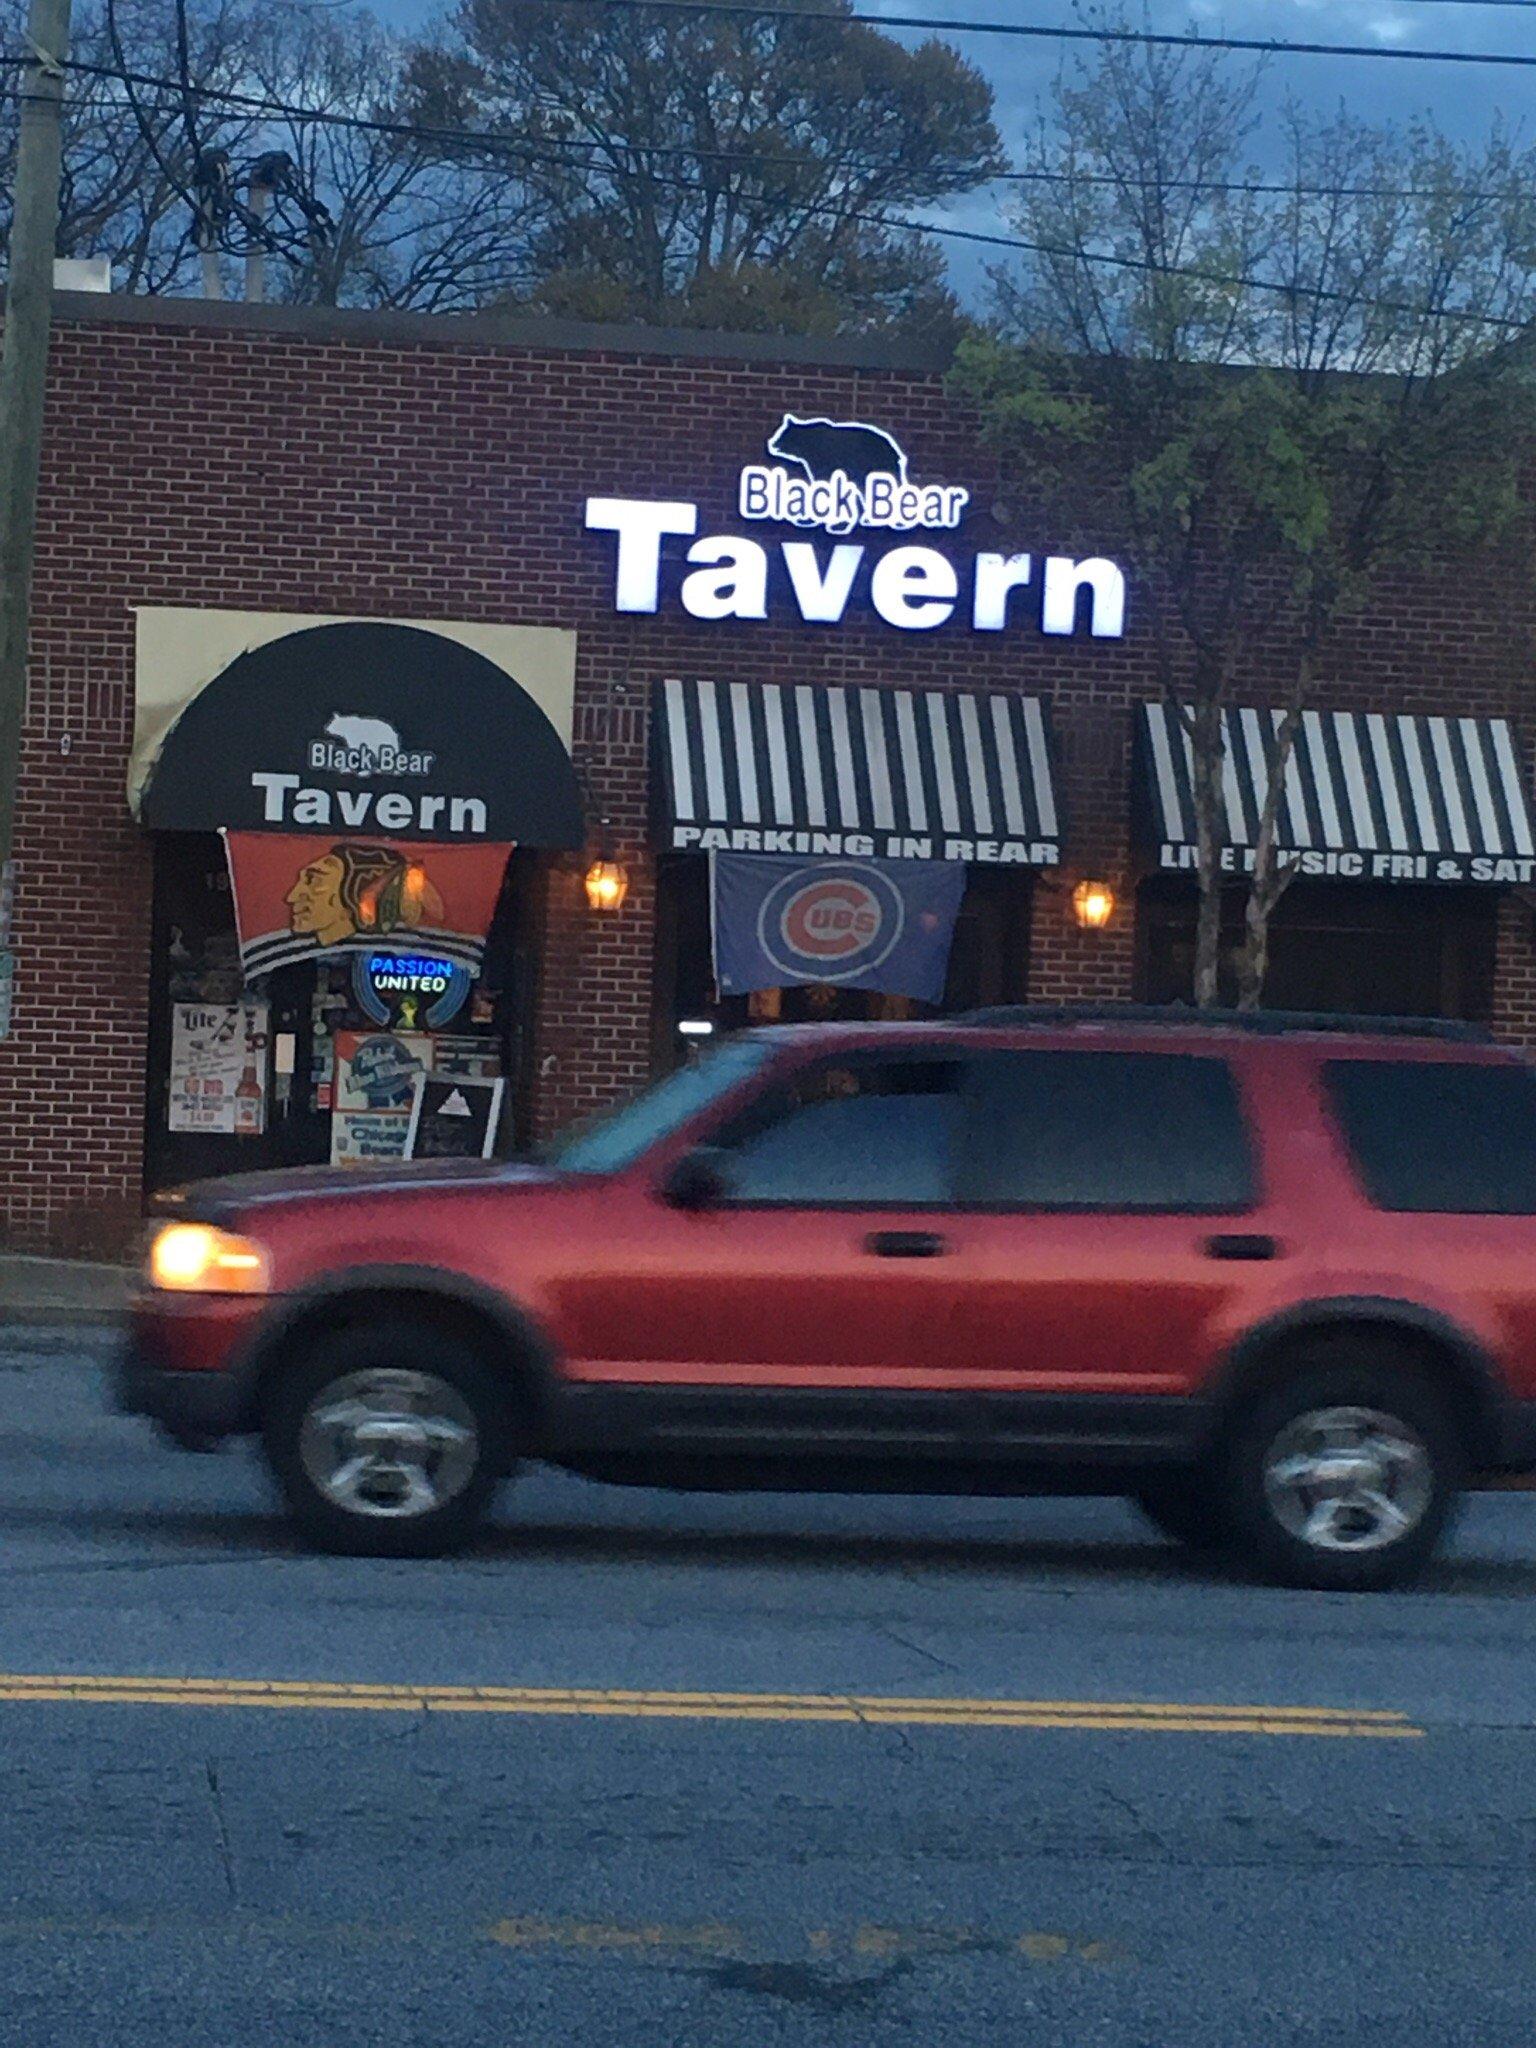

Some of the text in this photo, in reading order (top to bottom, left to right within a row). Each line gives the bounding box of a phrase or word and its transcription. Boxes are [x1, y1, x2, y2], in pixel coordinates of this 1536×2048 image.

[742, 467, 968, 528] Black Bear
[585, 497, 1125, 638] Tavern
[311, 742, 434, 773] Black Bear
[251, 772, 487, 833] Tavern
[673, 826, 1060, 865] PARKING IN REAR
[1372, 854, 1427, 879] FRI
[1436, 859, 1464, 881] &
[1470, 857, 1536, 883] SAT
[370, 957, 454, 977] PASSION
[374, 975, 447, 992] UNITED
